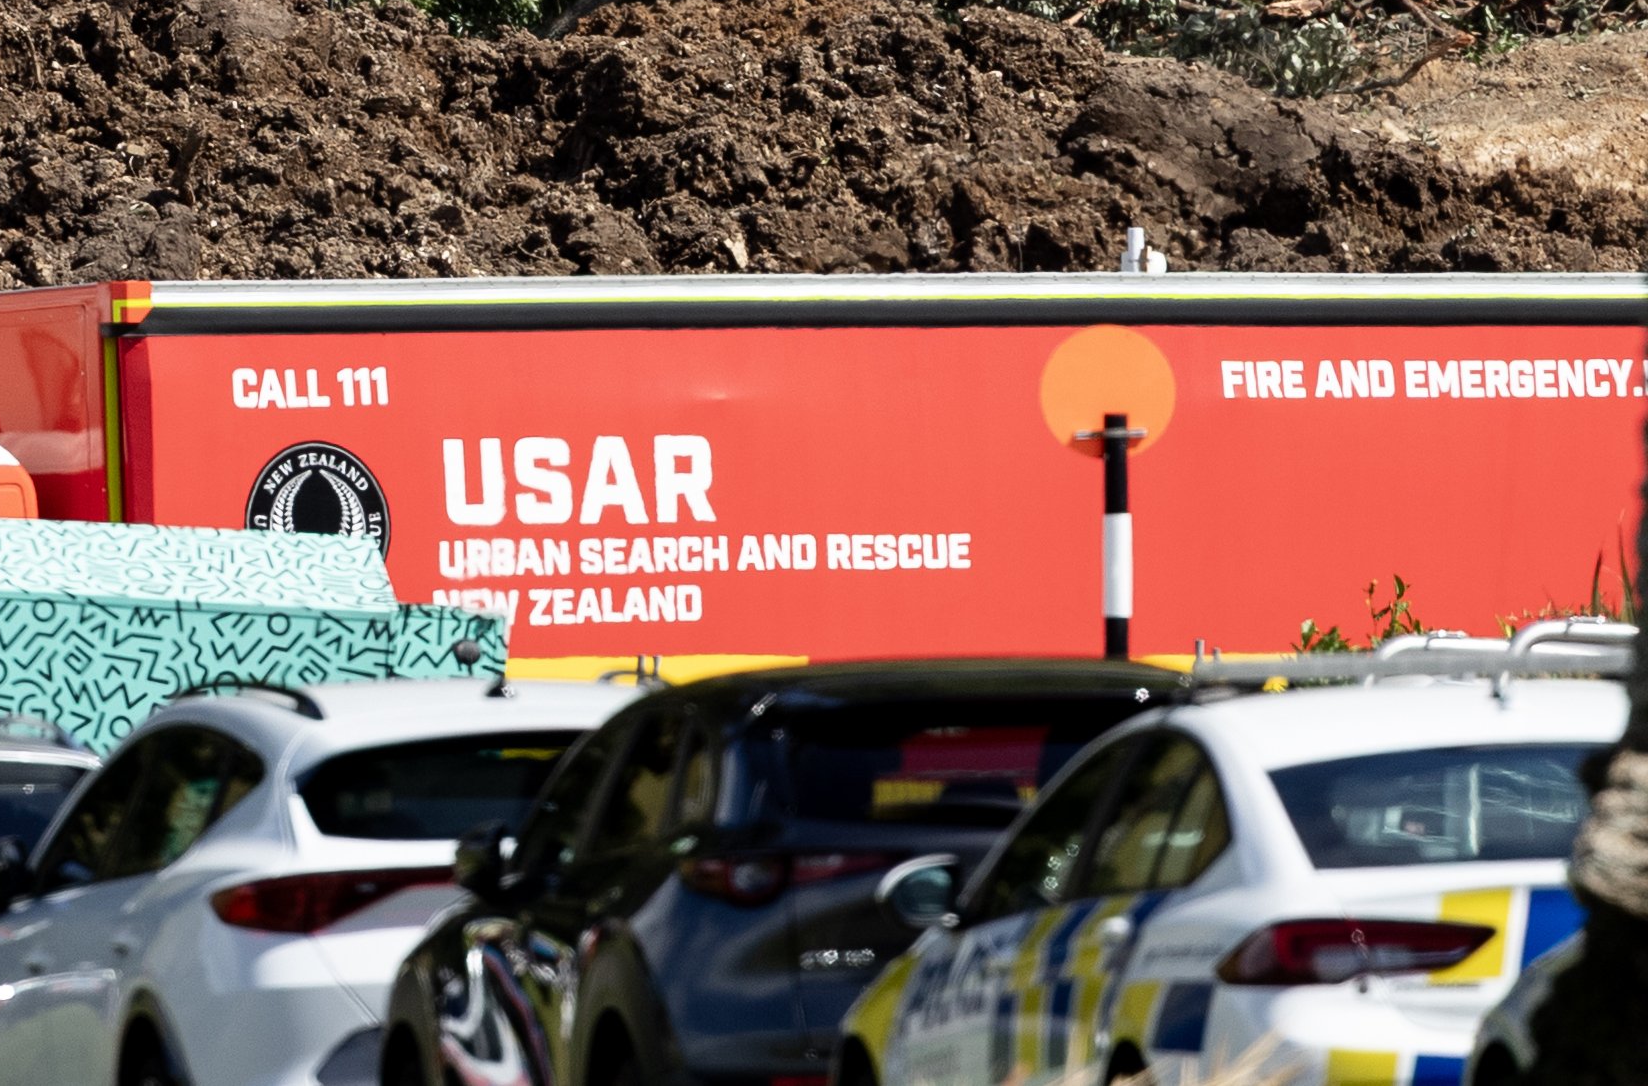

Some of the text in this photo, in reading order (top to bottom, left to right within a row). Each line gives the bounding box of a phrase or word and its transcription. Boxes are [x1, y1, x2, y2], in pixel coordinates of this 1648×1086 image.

[232, 366, 389, 410] CALL 111
[1221, 358, 1648, 399] FIRE AND EMERGENCY.
[263, 452, 369, 495] NEW ZEALAND
[442, 434, 718, 526] USAR
[439, 533, 972, 580] URBAN SEARCH AND RESCUE
[528, 584, 703, 626] ZEALAND
